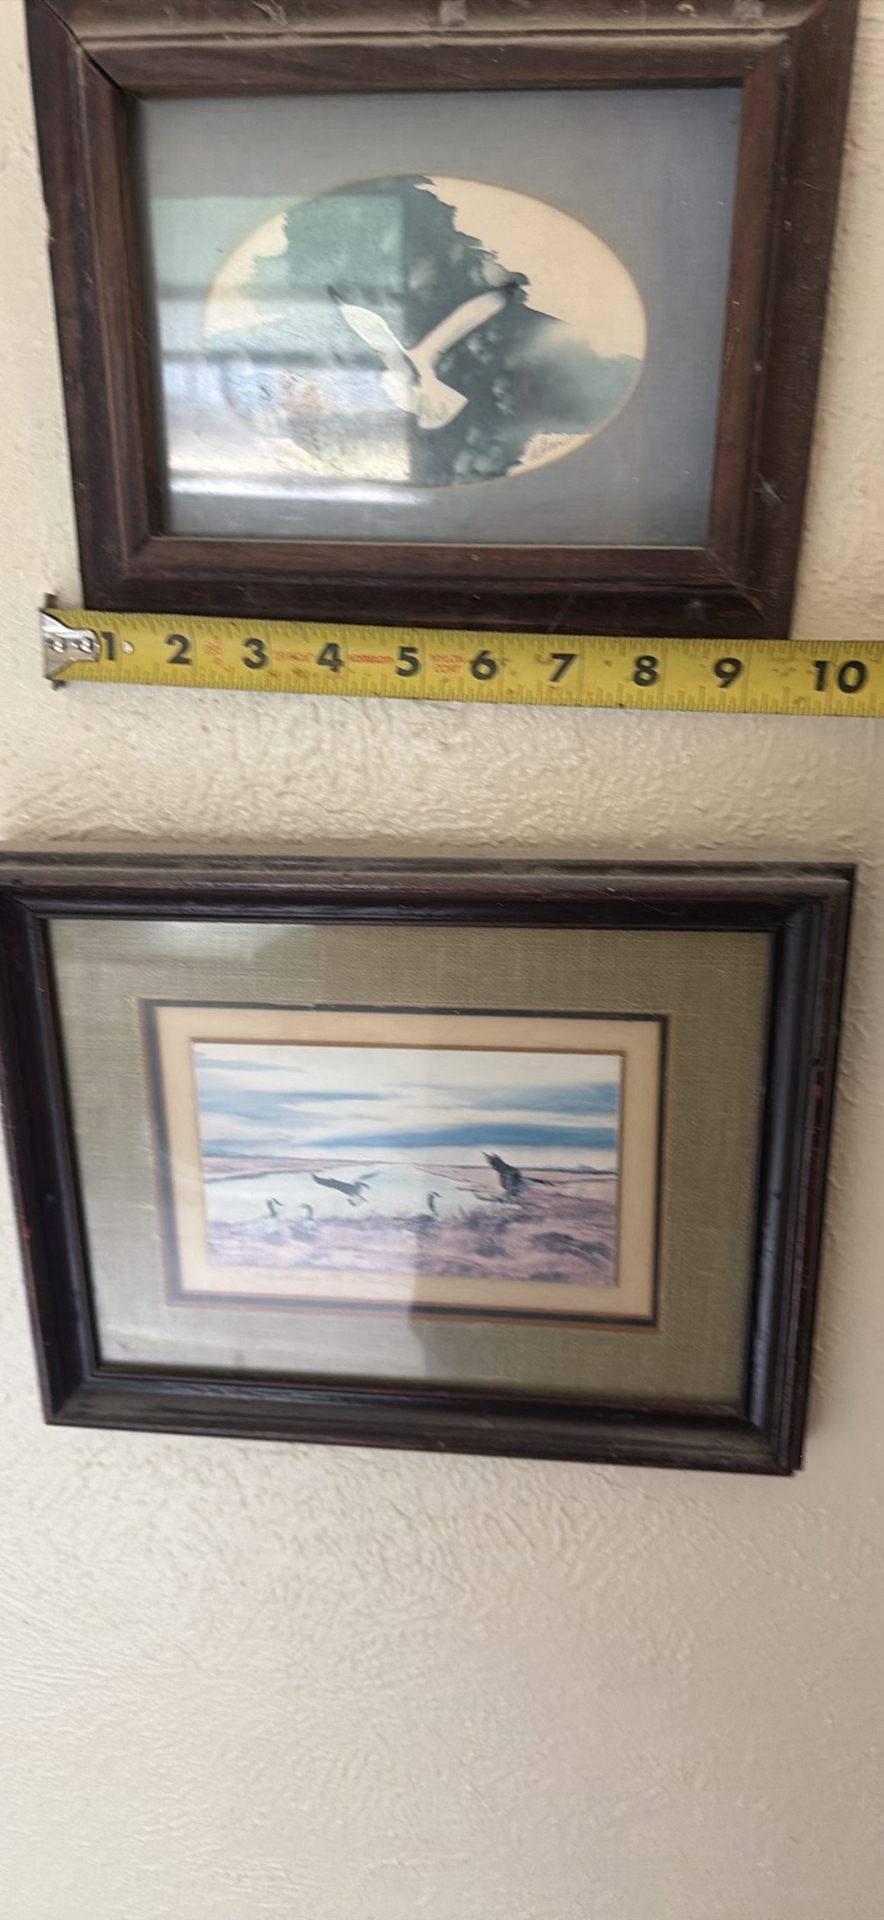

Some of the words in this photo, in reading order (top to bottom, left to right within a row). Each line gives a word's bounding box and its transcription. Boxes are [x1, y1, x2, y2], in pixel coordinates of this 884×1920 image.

[101, 631, 117, 662] 1
[164, 633, 193, 665] 2
[242, 637, 270, 670] 3
[316, 642, 345, 673] 4
[395, 646, 421, 678] 5
[470, 650, 498, 681] 6
[550, 653, 578, 683] 7
[632, 655, 660, 687] 8
[714, 657, 744, 689] 9
[812, 660, 867, 694] 10
